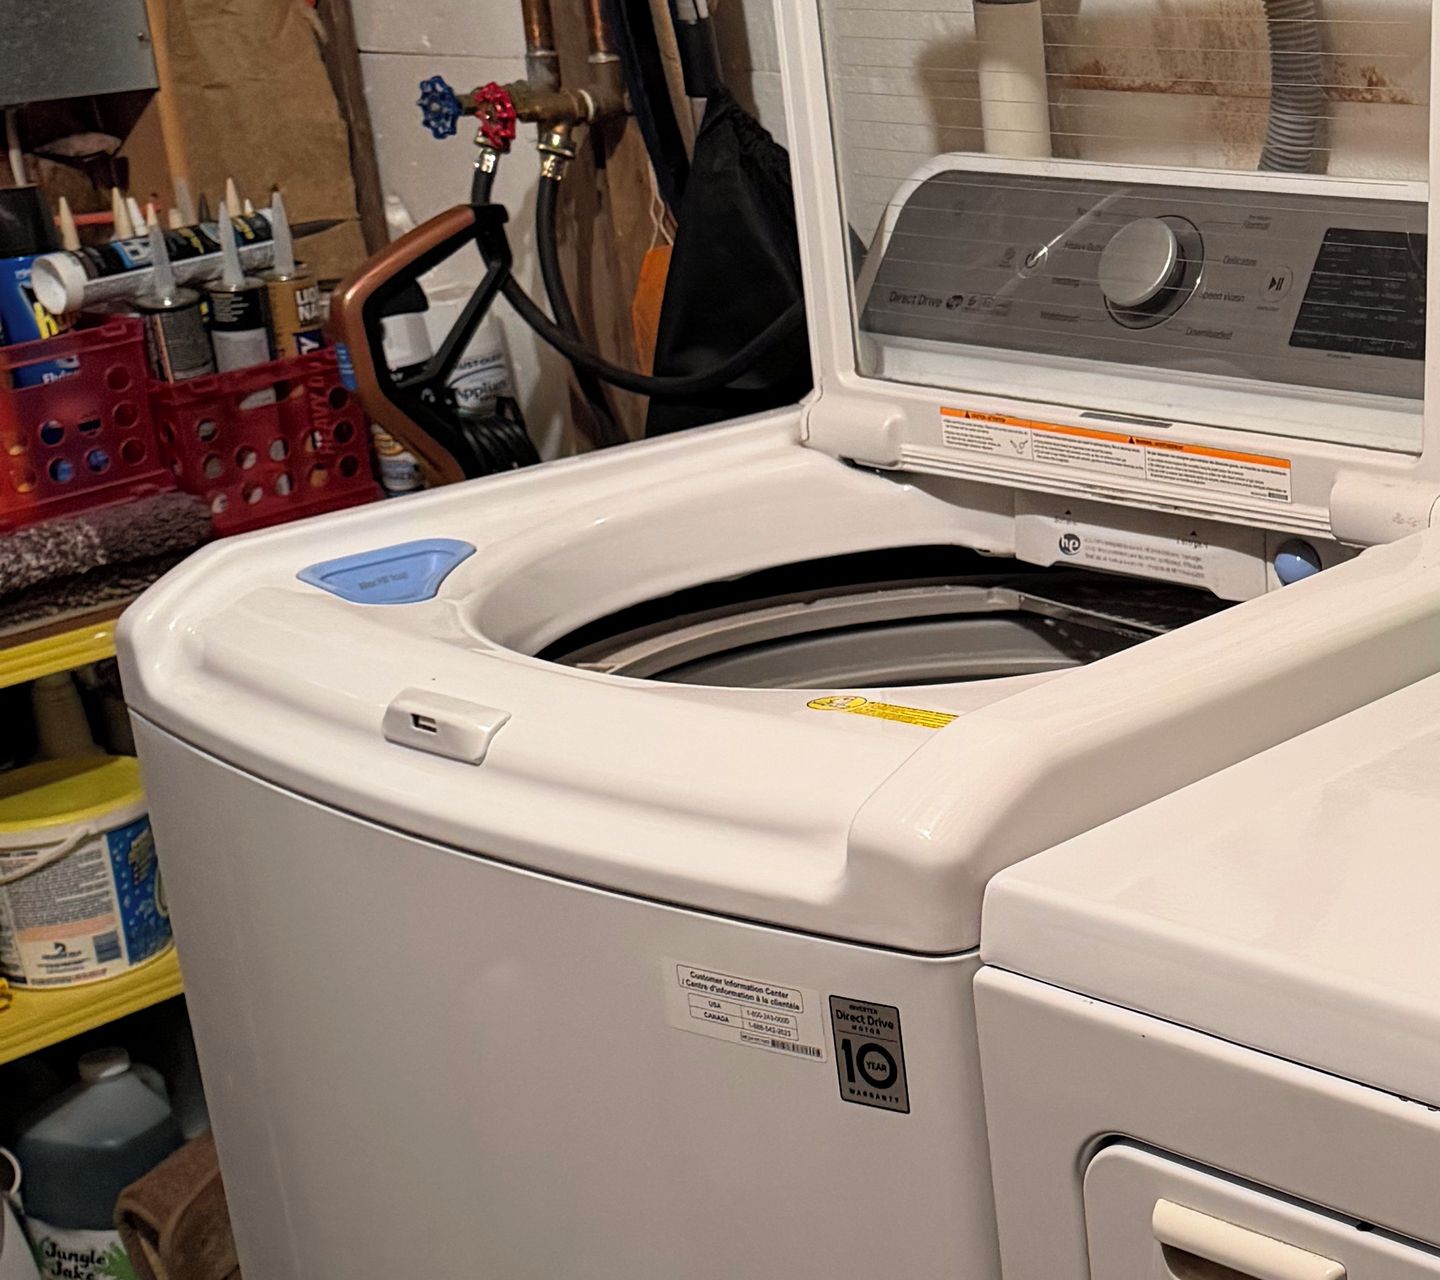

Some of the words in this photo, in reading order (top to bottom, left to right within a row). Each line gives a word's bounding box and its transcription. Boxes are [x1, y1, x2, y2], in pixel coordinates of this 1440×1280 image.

[889, 290, 917, 304] Direct
[918, 294, 943, 307] Drive
[686, 979, 708, 991] Centre
[709, 984, 754, 1001] d'information
[762, 996, 769, 1004] la
[690, 970, 723, 985] Customer
[724, 978, 764, 994] Information
[765, 987, 789, 999] Center
[708, 1000, 722, 1009] USA
[848, 1004, 878, 1015] INVERTER
[703, 1011, 729, 1023] CANADA
[835, 1009, 866, 1024] Direct
[867, 1015, 894, 1030] Drive
[851, 1025, 880, 1035] MOTOR
[841, 1038, 897, 1090] 10
[866, 1061, 887, 1072] YEAR
[848, 1087, 899, 1103] WARRANTY
[45, 1241, 105, 1268] Jungle
[50, 1261, 95, 1280] Jake
